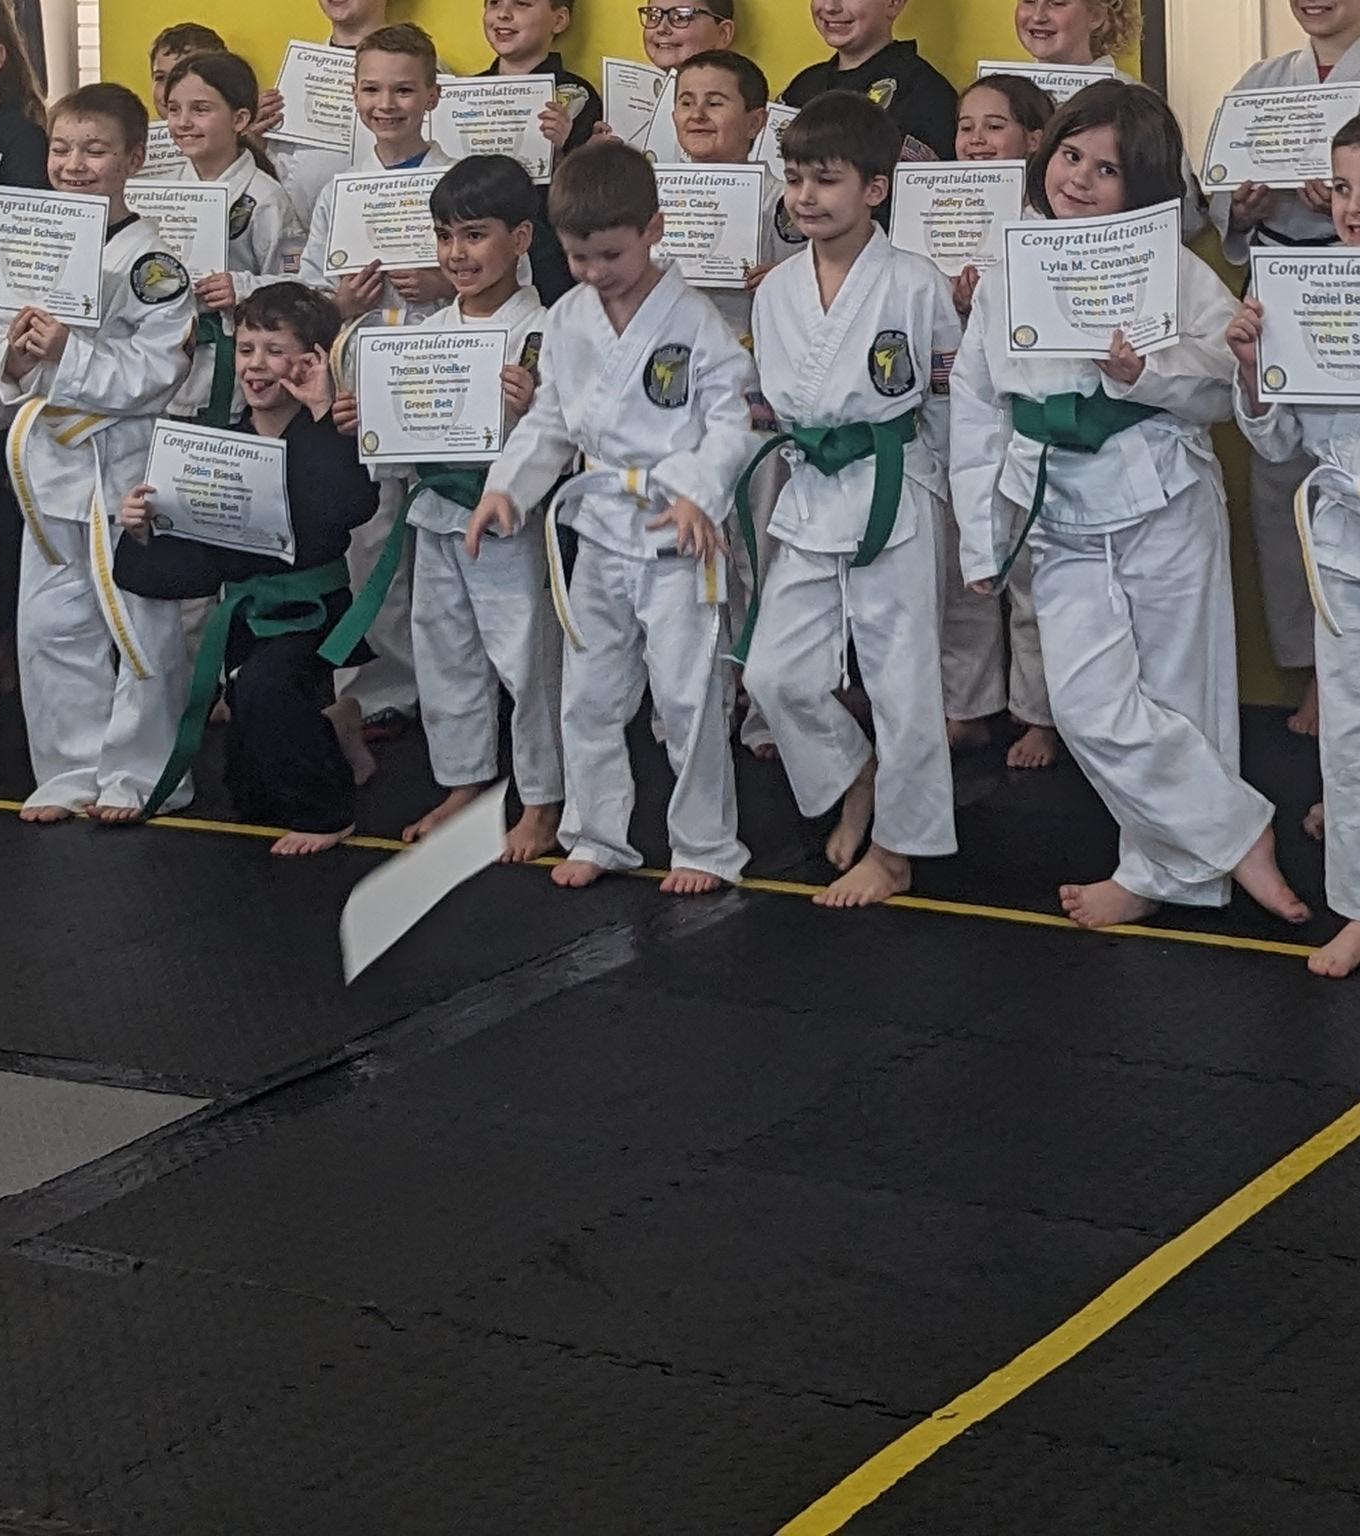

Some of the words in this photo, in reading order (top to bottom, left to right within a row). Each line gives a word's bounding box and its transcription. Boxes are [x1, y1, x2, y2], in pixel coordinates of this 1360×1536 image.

[906, 169, 1013, 189] Congratulations...
[1022, 221, 1168, 251] Congratulations...
[1041, 261, 1068, 273] Lyla
[1072, 261, 1086, 271] M.
[1090, 250, 1155, 270] Cavanaugh
[1072, 296, 1108, 306] Green
[1112, 293, 1133, 304] Belt
[1303, 293, 1341, 304] Daniel
[371, 334, 494, 356] Congratulations...
[1311, 333, 1349, 344] Yellow
[391, 365, 429, 376] Thomas
[405, 400, 432, 409] Green
[434, 399, 453, 408] Belt
